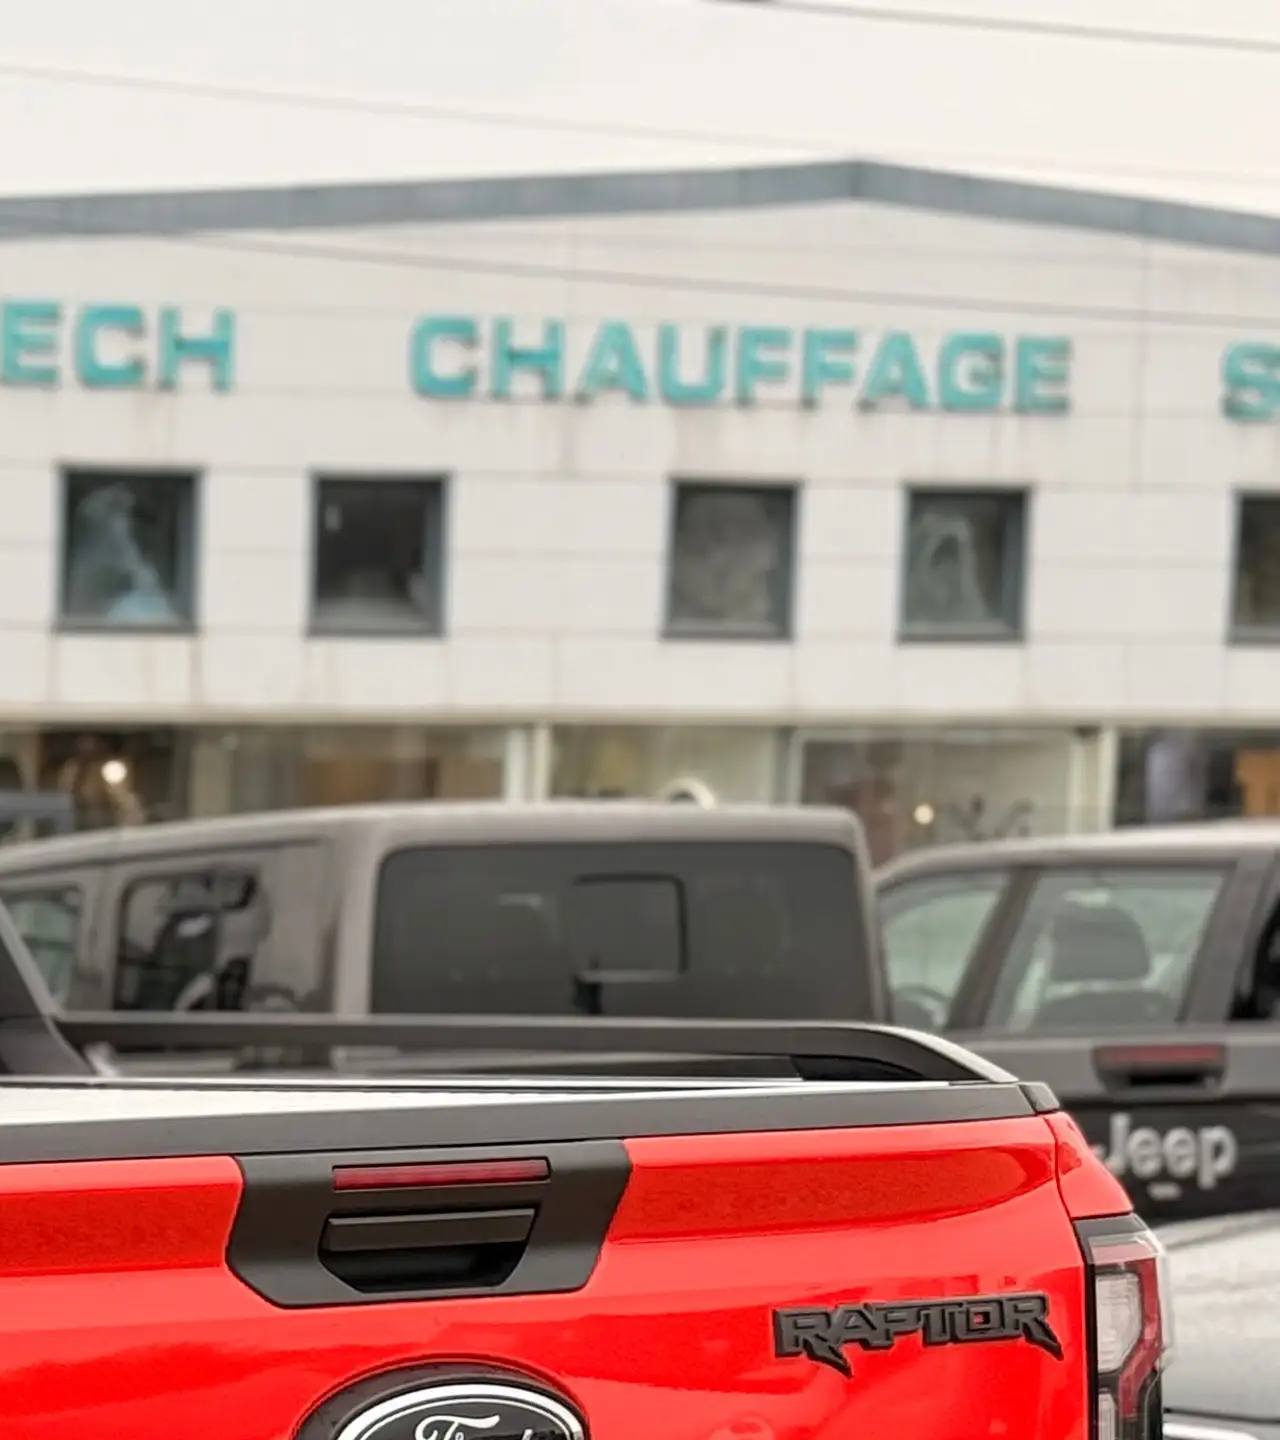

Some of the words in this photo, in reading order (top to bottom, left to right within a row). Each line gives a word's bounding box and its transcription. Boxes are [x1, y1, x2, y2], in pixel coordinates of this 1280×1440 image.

[407, 314, 1074, 412] CHAUFFAGE
[1102, 1112, 1238, 1190] Jeep
[772, 1293, 1063, 1378] RAPTOR
